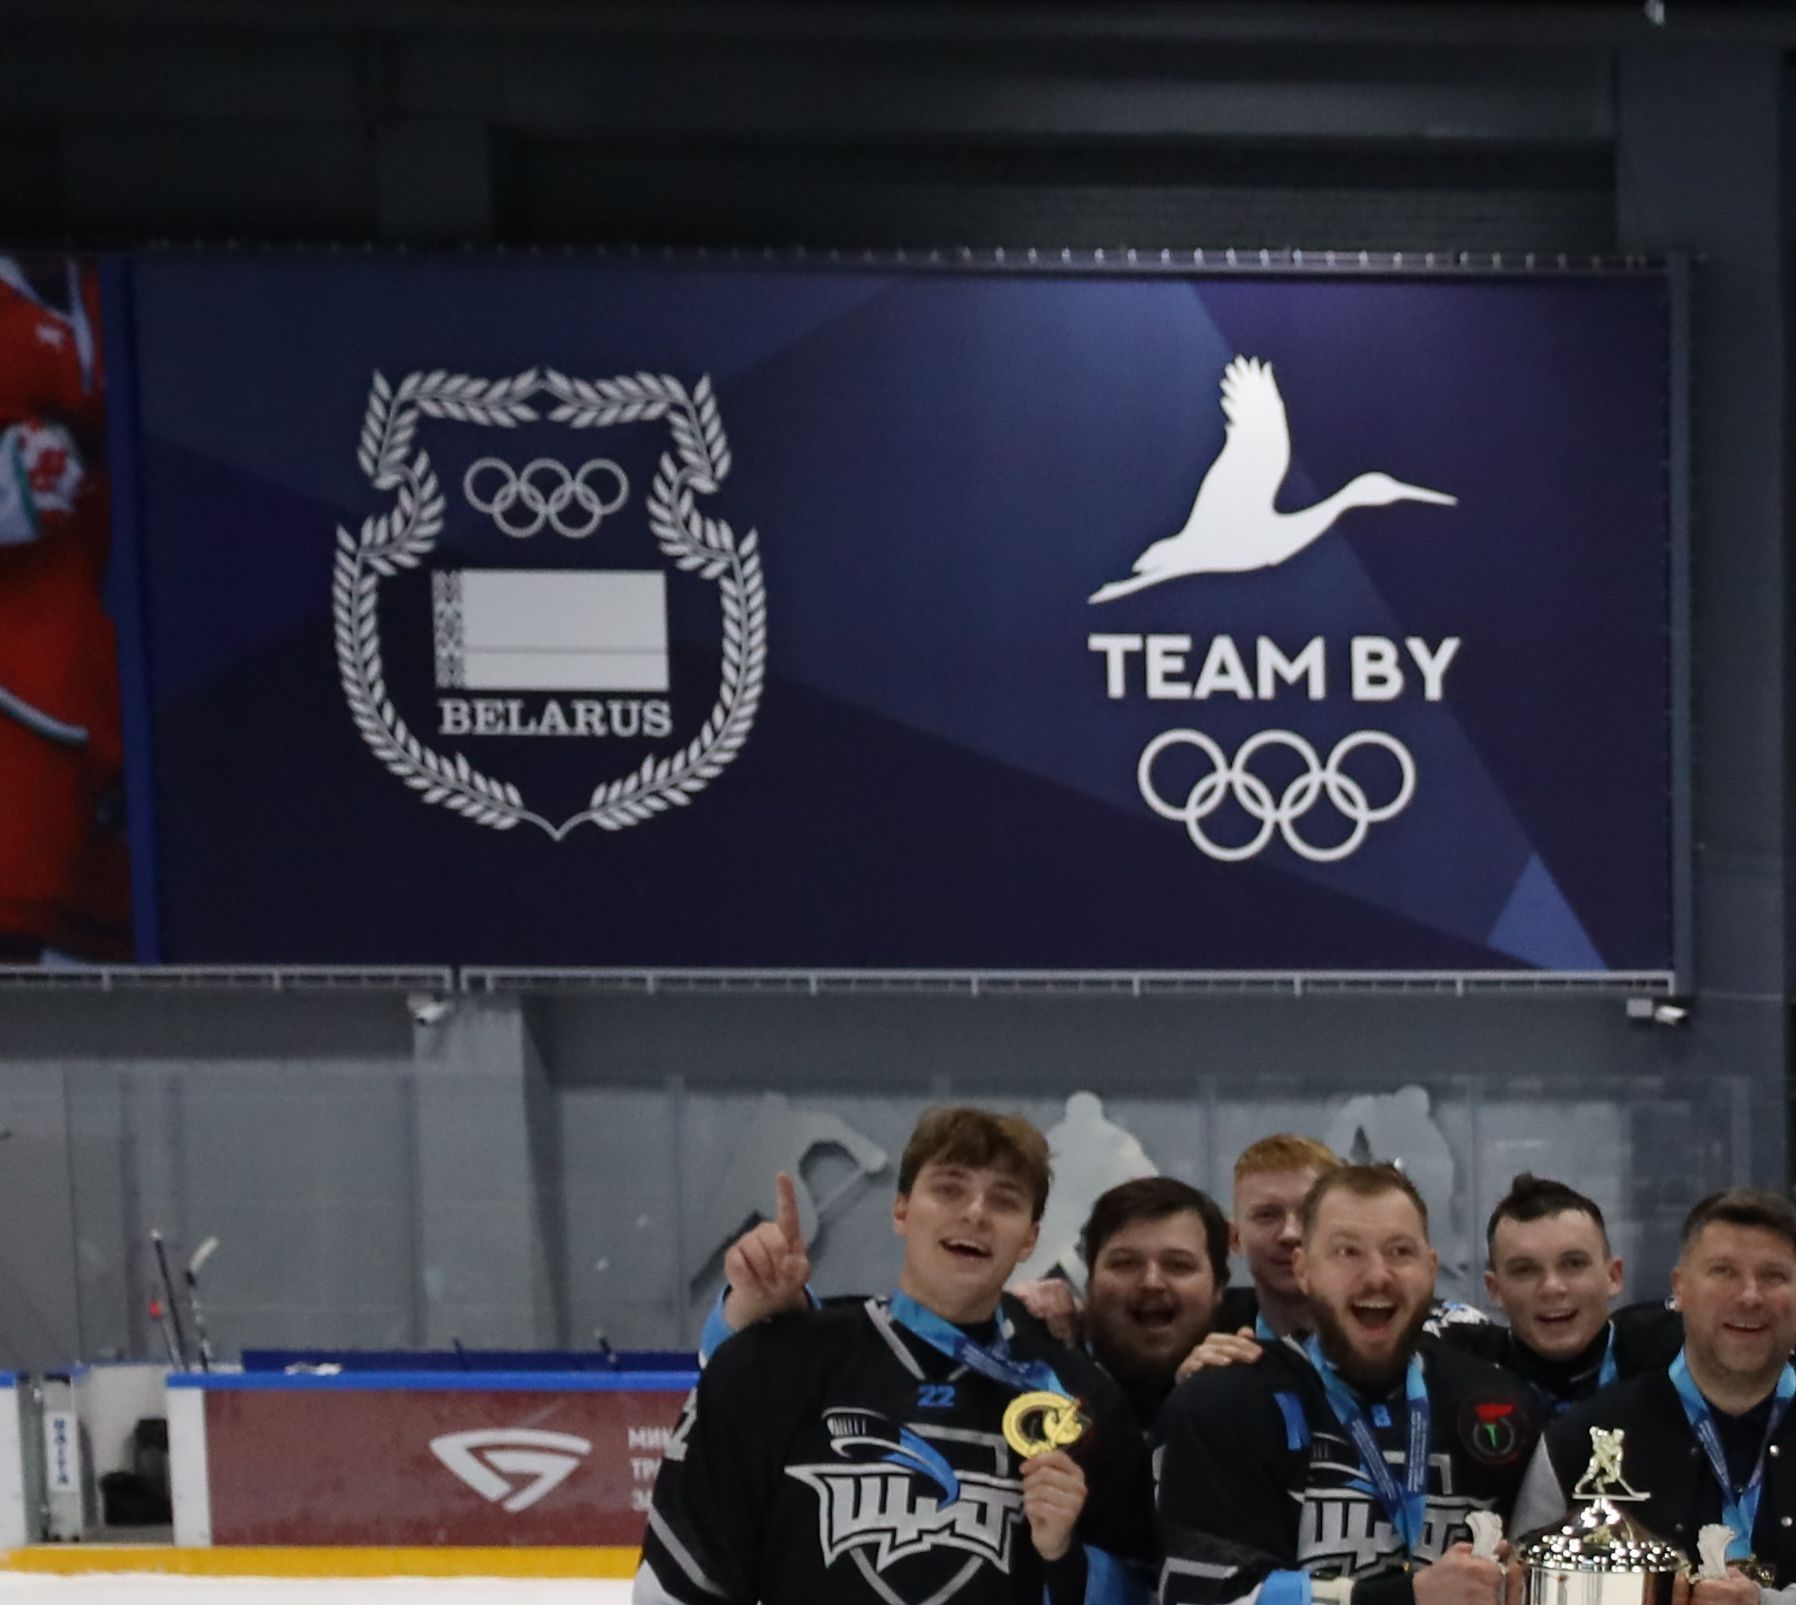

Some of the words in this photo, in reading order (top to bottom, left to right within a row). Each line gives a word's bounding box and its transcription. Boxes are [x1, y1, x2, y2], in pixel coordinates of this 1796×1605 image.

[1088, 633, 1326, 700] TEAM
[1352, 637, 1461, 702] BY
[438, 698, 674, 738] BELARUS
[916, 1384, 957, 1407] 22
